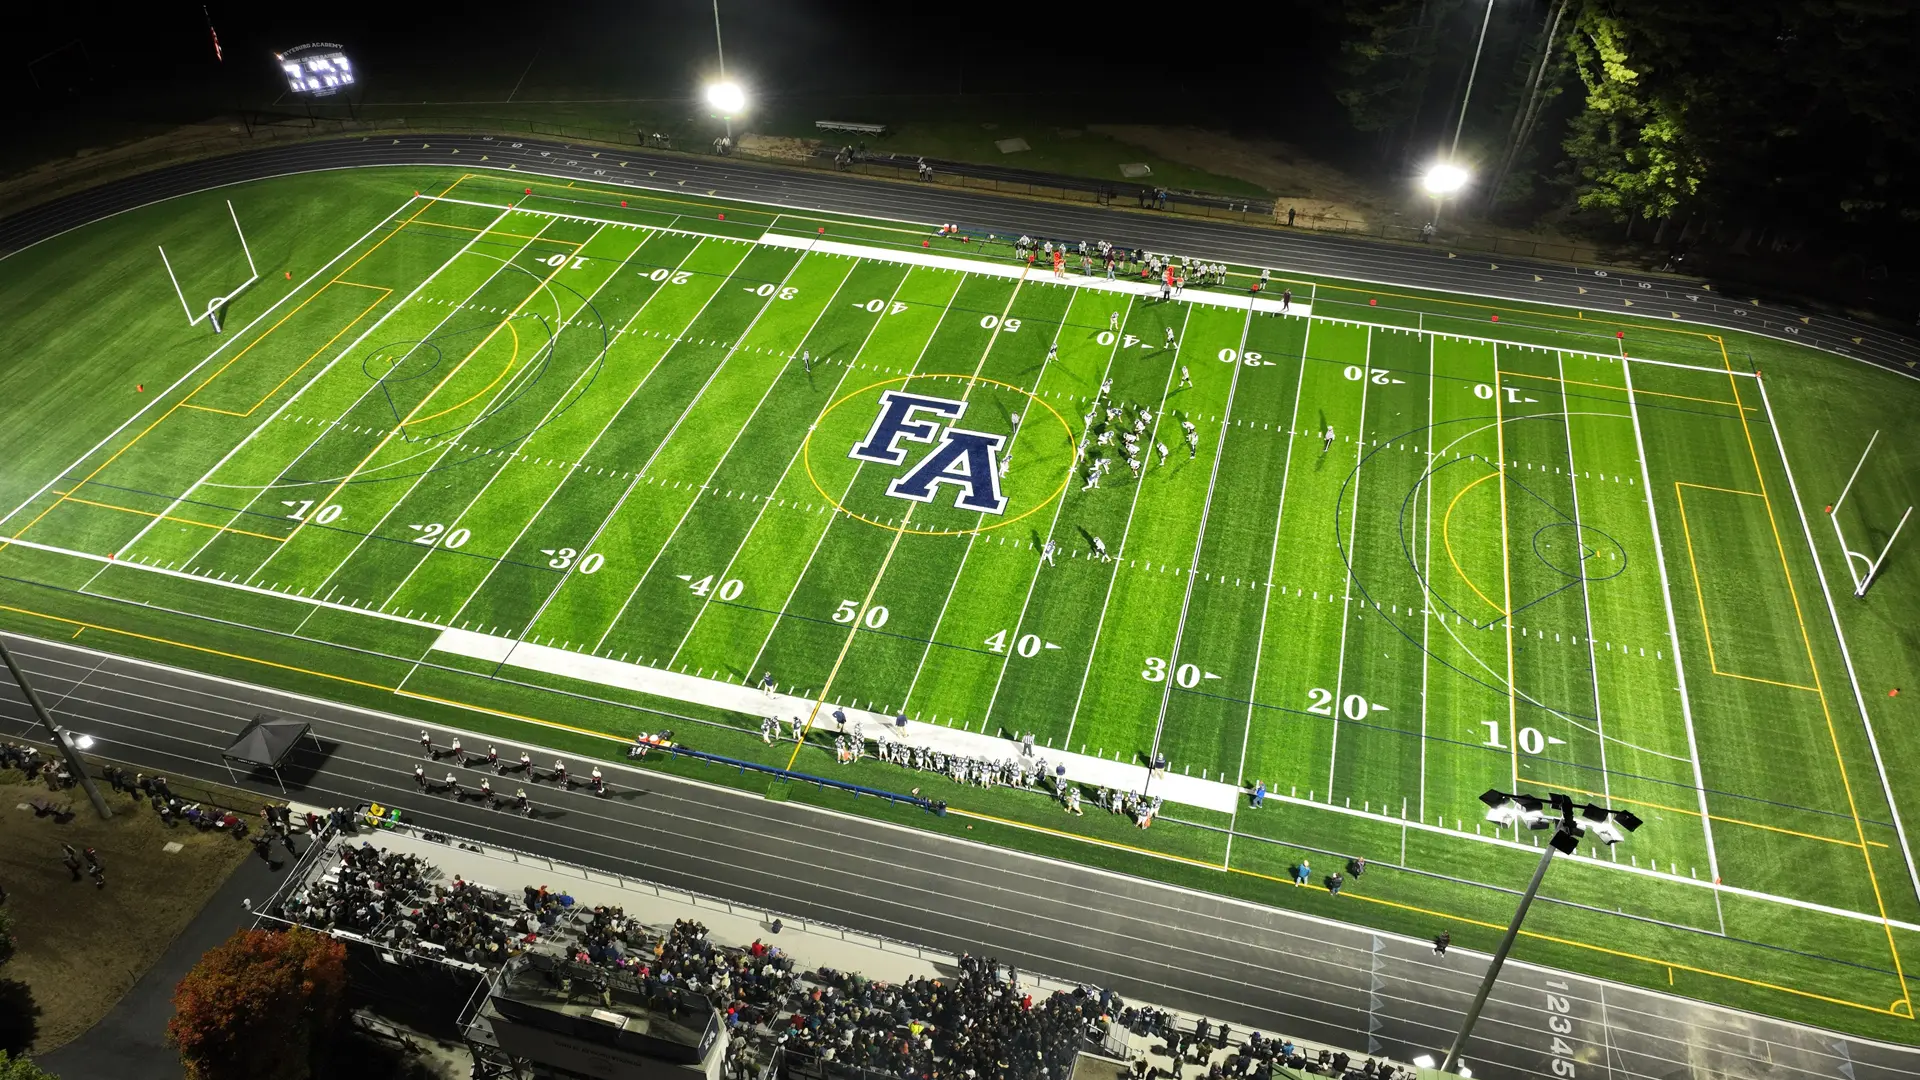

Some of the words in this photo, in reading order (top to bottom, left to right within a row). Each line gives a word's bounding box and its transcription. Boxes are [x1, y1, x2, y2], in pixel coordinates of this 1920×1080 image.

[281, 43, 311, 57] RYEBURG
[312, 42, 344, 50] ACADEMY
[547, 253, 590, 270] 10
[647, 268, 694, 285] 20
[756, 283, 799, 301] 30
[866, 298, 909, 316] 40
[980, 315, 1022, 333] 50
[1096, 331, 1141, 349] 40
[1218, 348, 1262, 367] 30
[1343, 365, 1390, 385] 20
[1473, 383, 1522, 403] 10
[847, 389, 1010, 516] FA
[286, 500, 343, 525] 10
[413, 523, 471, 549] 20
[549, 548, 605, 574] 30
[689, 575, 744, 601] 40
[832, 600, 889, 629] 50
[984, 629, 1041, 658] 40
[1141, 657, 1200, 689] 30
[1307, 687, 1368, 720] 20
[1480, 720, 1544, 755] 10
